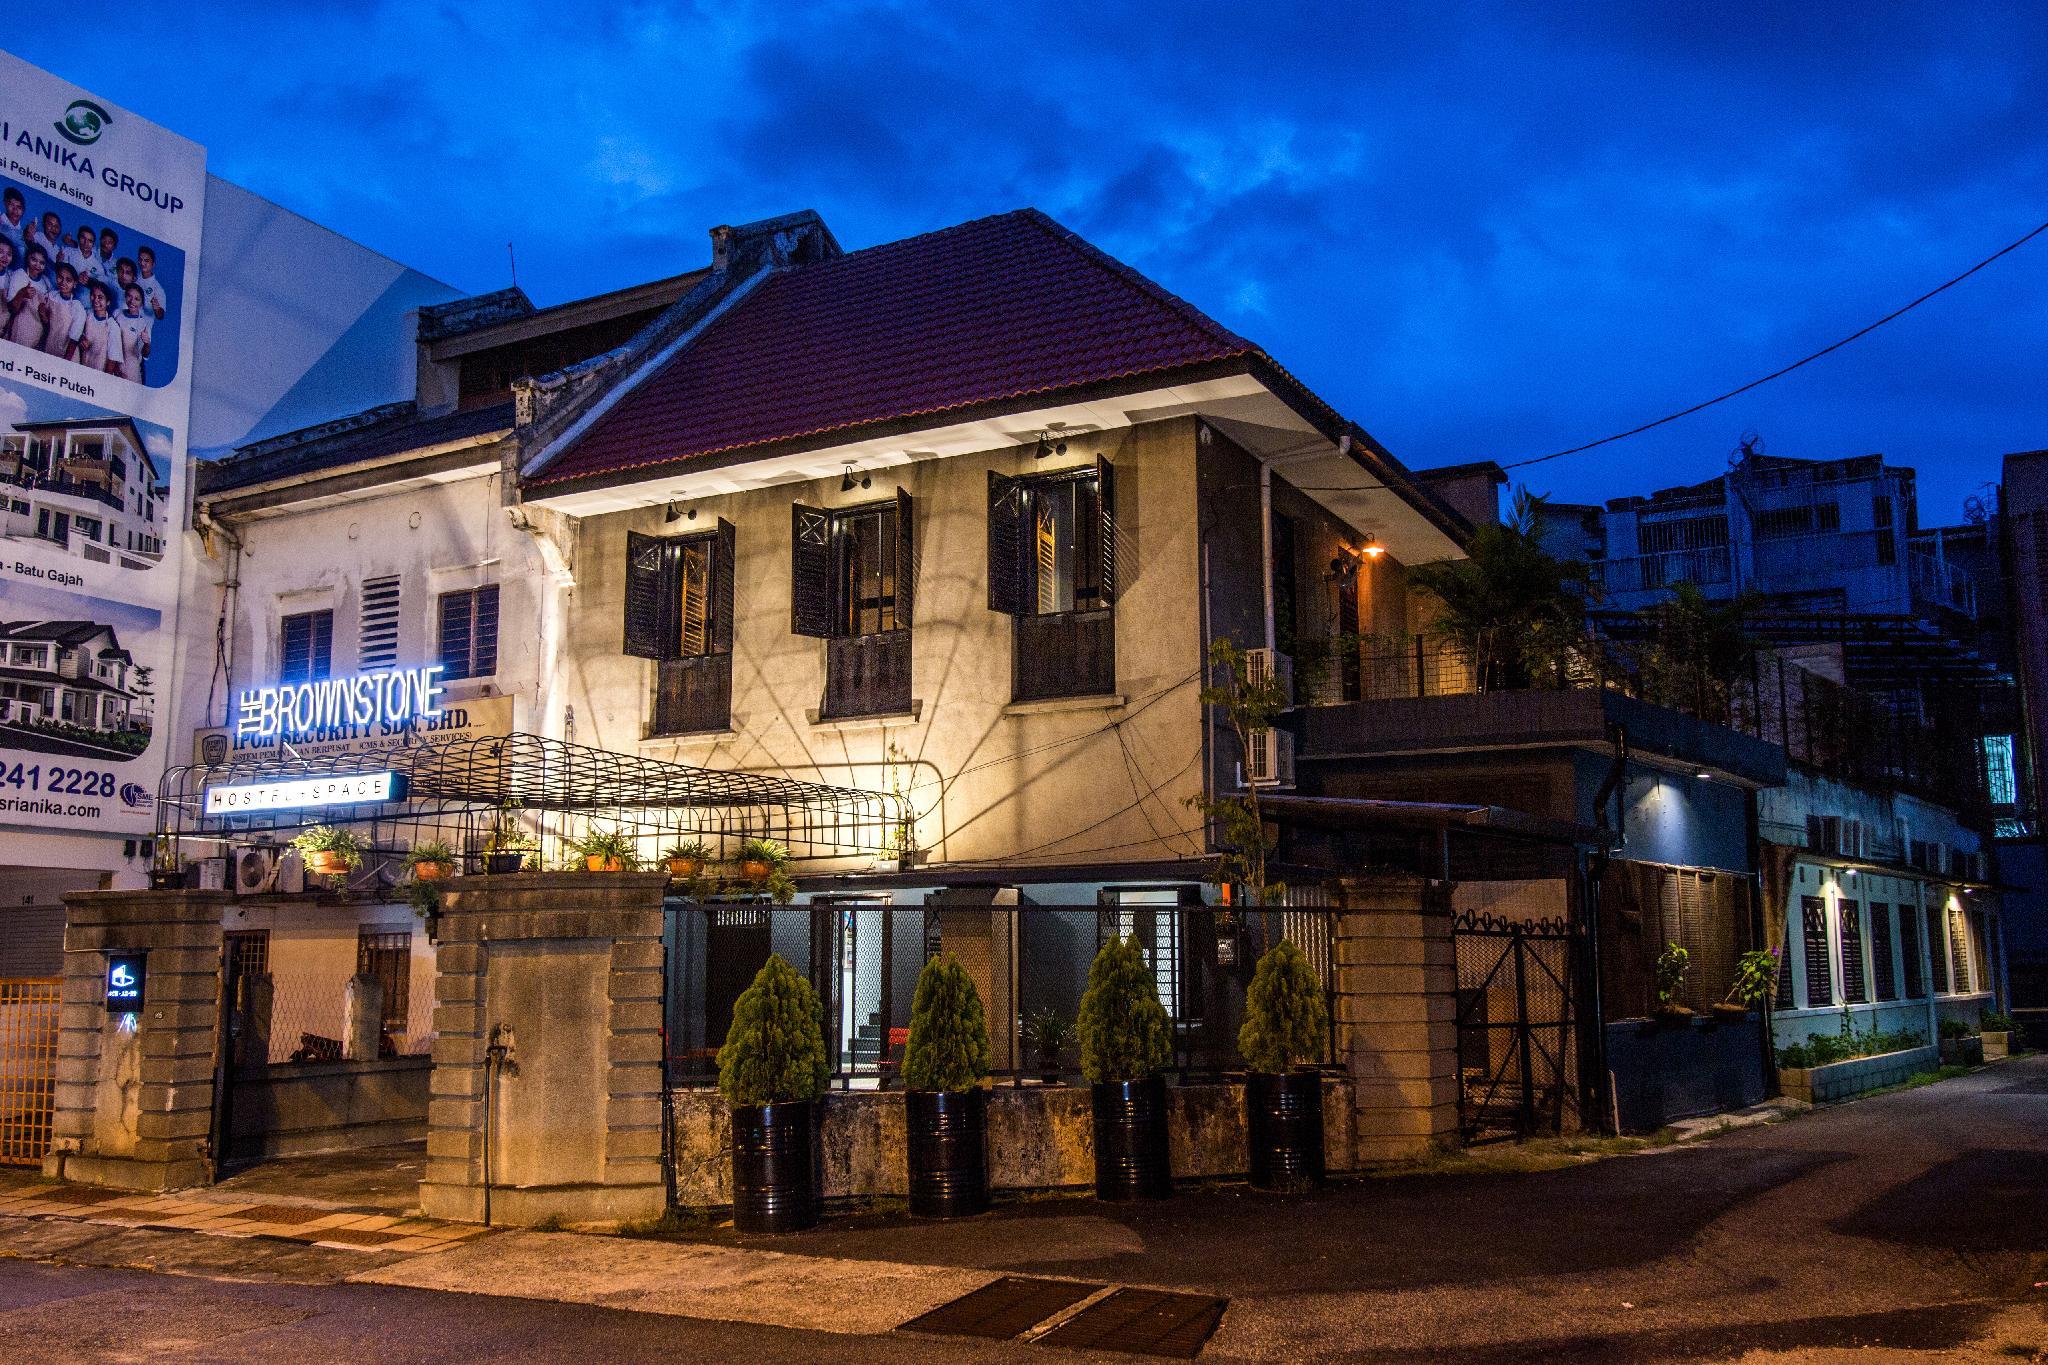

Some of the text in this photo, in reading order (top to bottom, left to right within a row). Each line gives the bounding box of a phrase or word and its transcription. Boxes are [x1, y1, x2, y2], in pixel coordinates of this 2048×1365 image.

[0, 121, 184, 213] I ANIKA GROUP
[10, 160, 57, 189] Pekerja
[59, 182, 94, 206] Asing
[25, 365, 57, 385] Pasir
[60, 377, 95, 397] Puteh
[15, 562, 44, 578] Batu
[48, 569, 83, 586] Gajah
[237, 666, 444, 737] THE BROWNSTONE
[427, 708, 472, 732] BHD.
[48, 767, 116, 798] 2228
[214, 789, 292, 807] HOSTEL
[313, 780, 382, 799] SPACE
